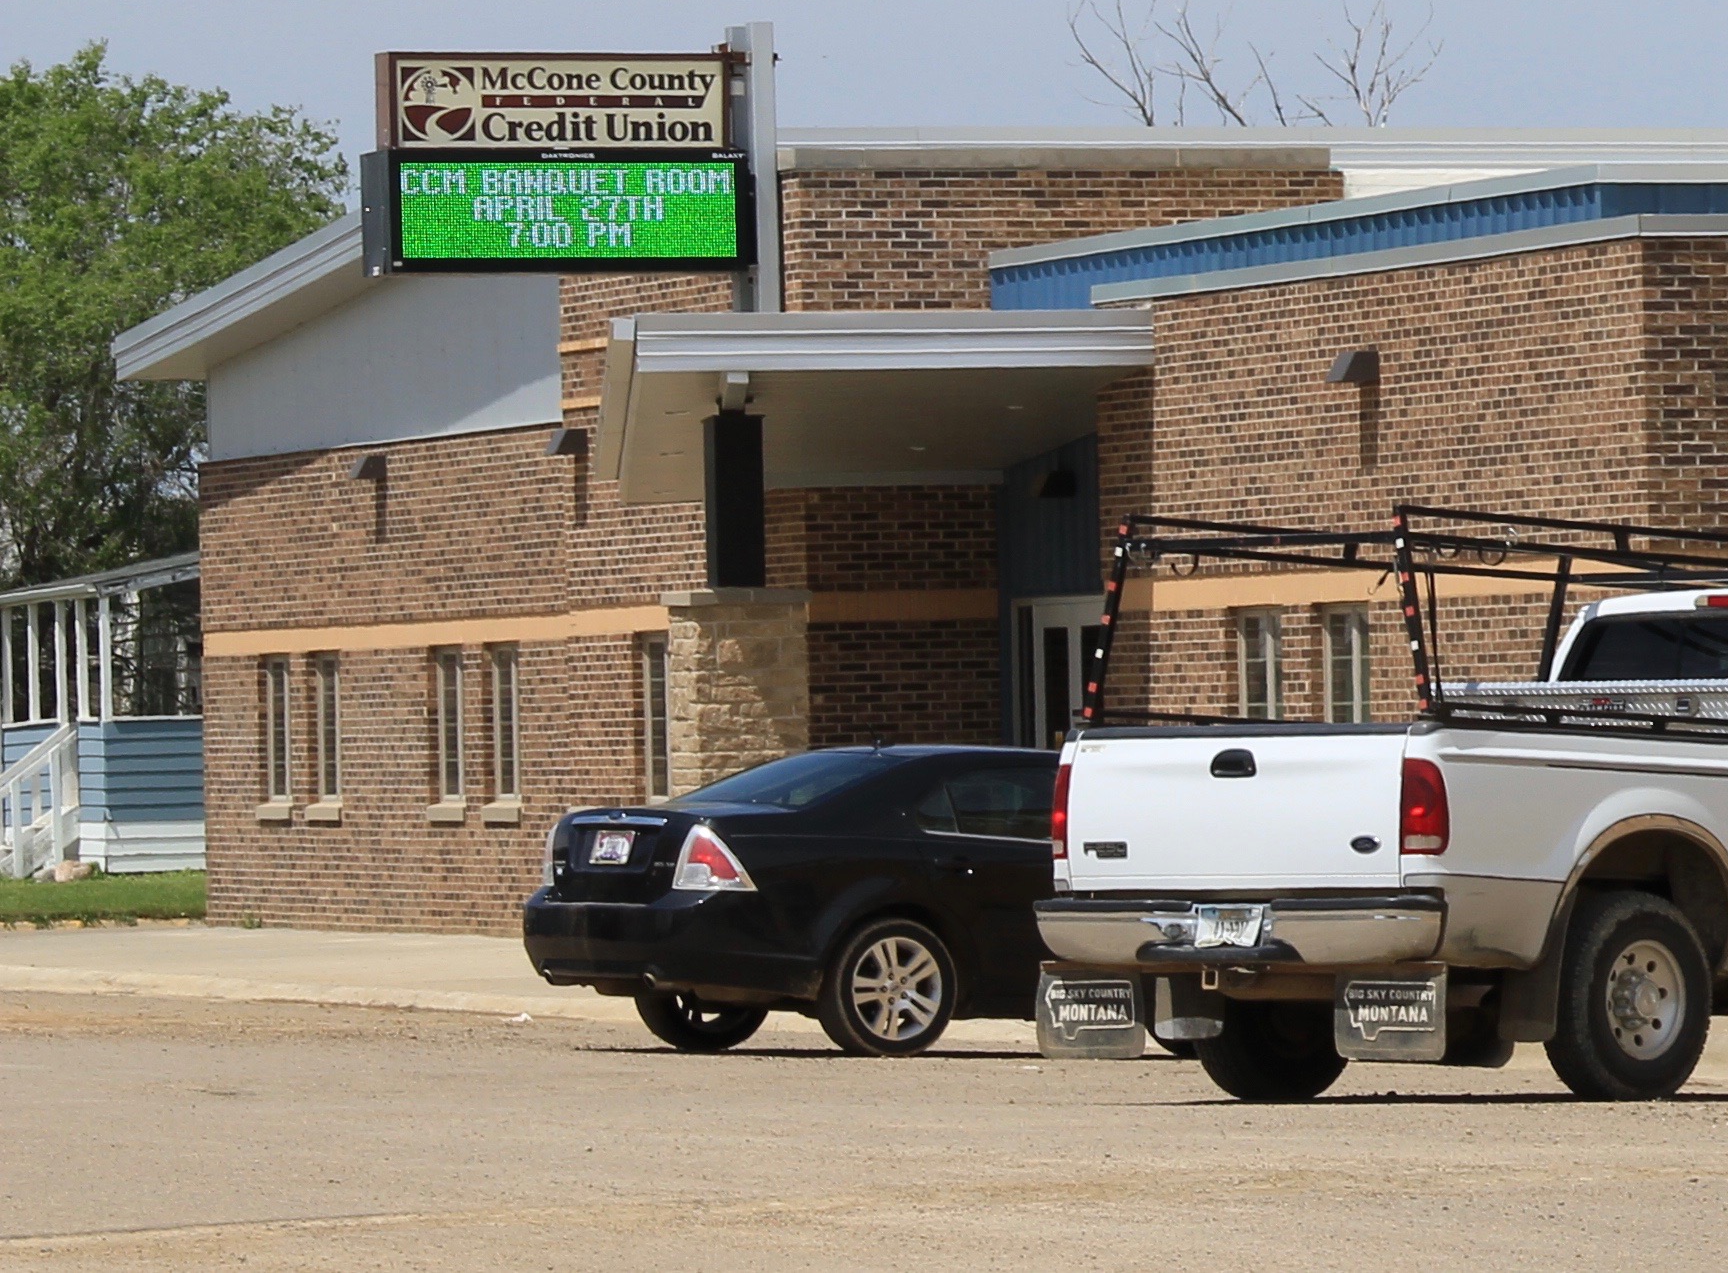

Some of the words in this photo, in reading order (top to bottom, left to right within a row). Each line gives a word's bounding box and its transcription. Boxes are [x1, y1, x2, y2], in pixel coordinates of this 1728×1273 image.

[481, 66, 600, 90] McCone
[610, 67, 716, 94] County
[495, 96, 695, 106] FEDERAL
[481, 112, 597, 142] Credit
[605, 112, 714, 142] Union
[401, 169, 466, 194] CCM
[482, 169, 629, 195] BANQUET
[645, 169, 730, 194] ROOM
[473, 196, 565, 221] APRIL
[581, 196, 664, 221] 27TH
[588, 222, 632, 247] PM
[1068, 989, 1086, 999] SKY
[1089, 988, 1131, 999] COUNTRY
[1367, 989, 1386, 1000] SKY
[1389, 989, 1433, 1001] COUNTRY
[1059, 1004, 1128, 1021] MONTANA
[1358, 1005, 1428, 1022] MONTANA
